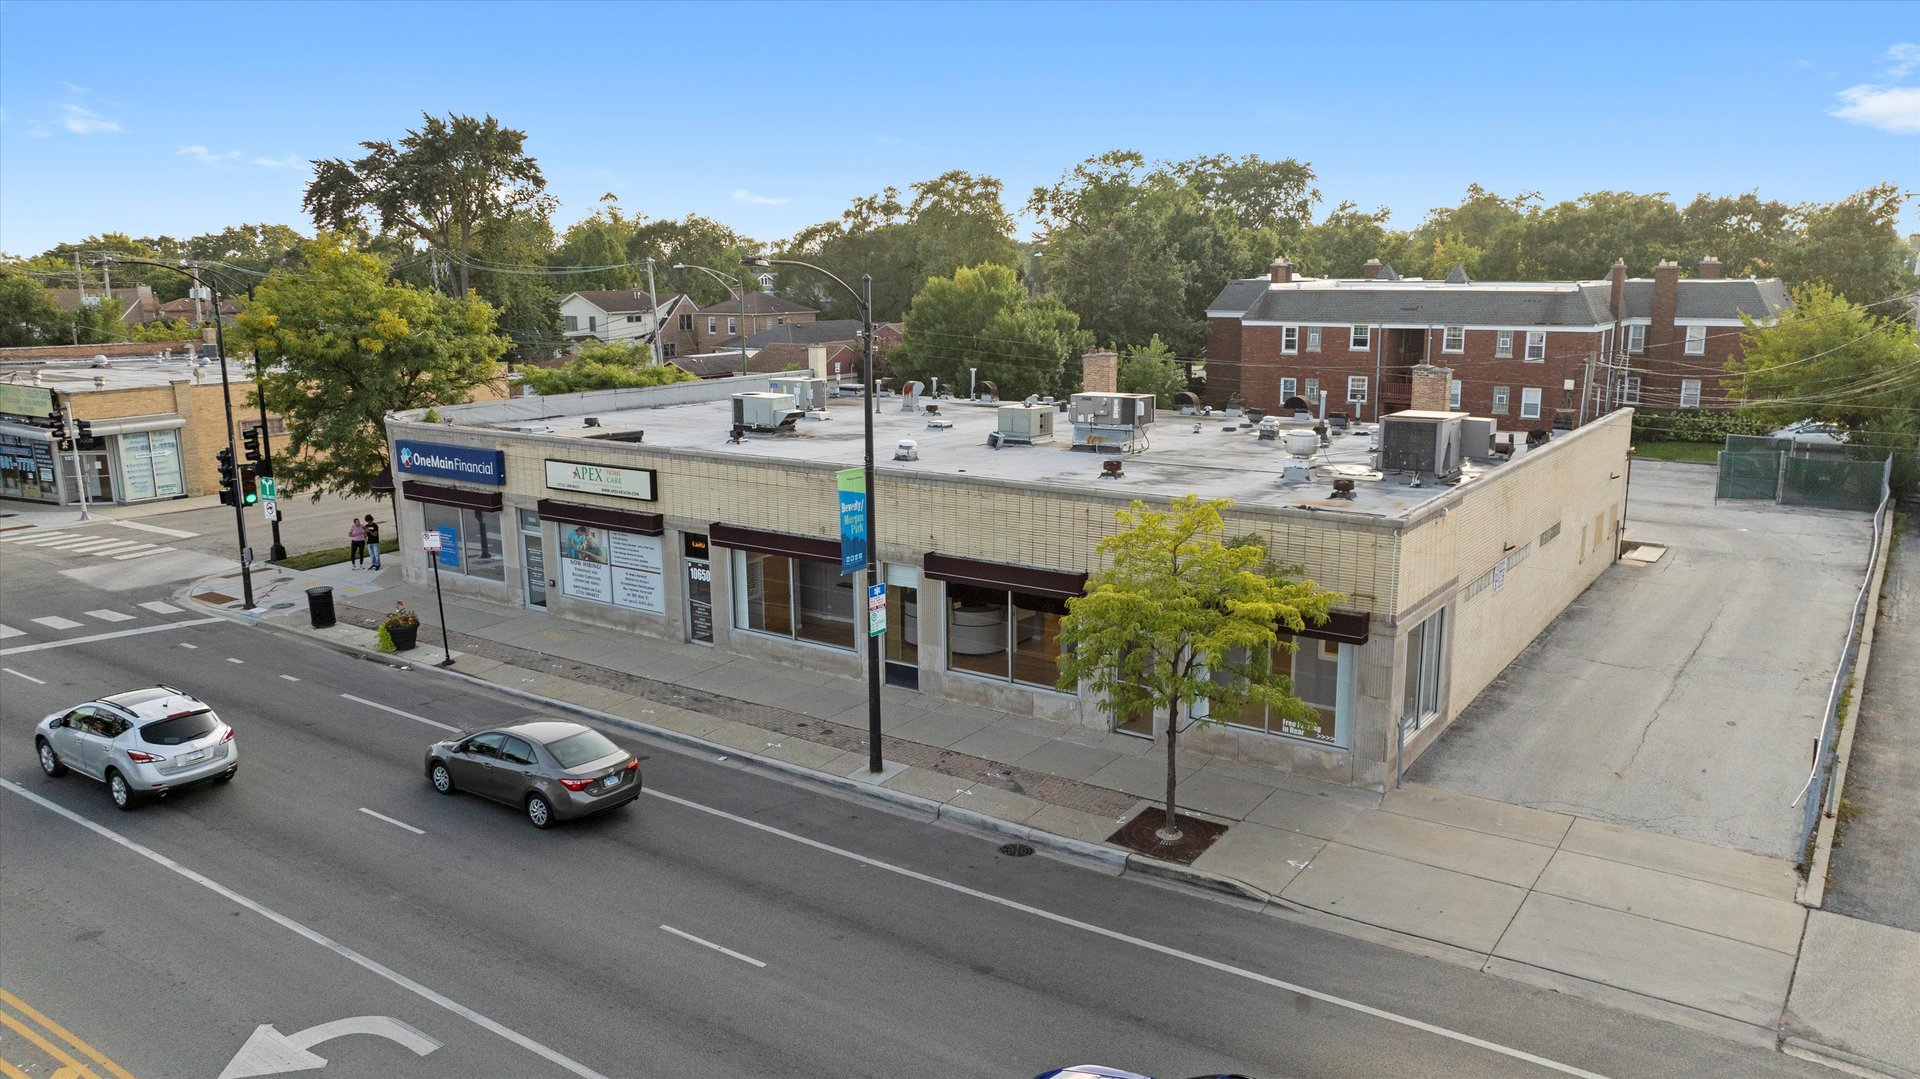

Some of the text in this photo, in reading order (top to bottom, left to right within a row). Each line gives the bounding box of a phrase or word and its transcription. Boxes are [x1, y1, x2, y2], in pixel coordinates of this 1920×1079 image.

[573, 466, 603, 482] APEX
[844, 514, 864, 525] Morgan
[570, 559, 602, 571] NOW HIRING!
[690, 567, 711, 583] 10650
[1290, 726, 1305, 736] Rear
